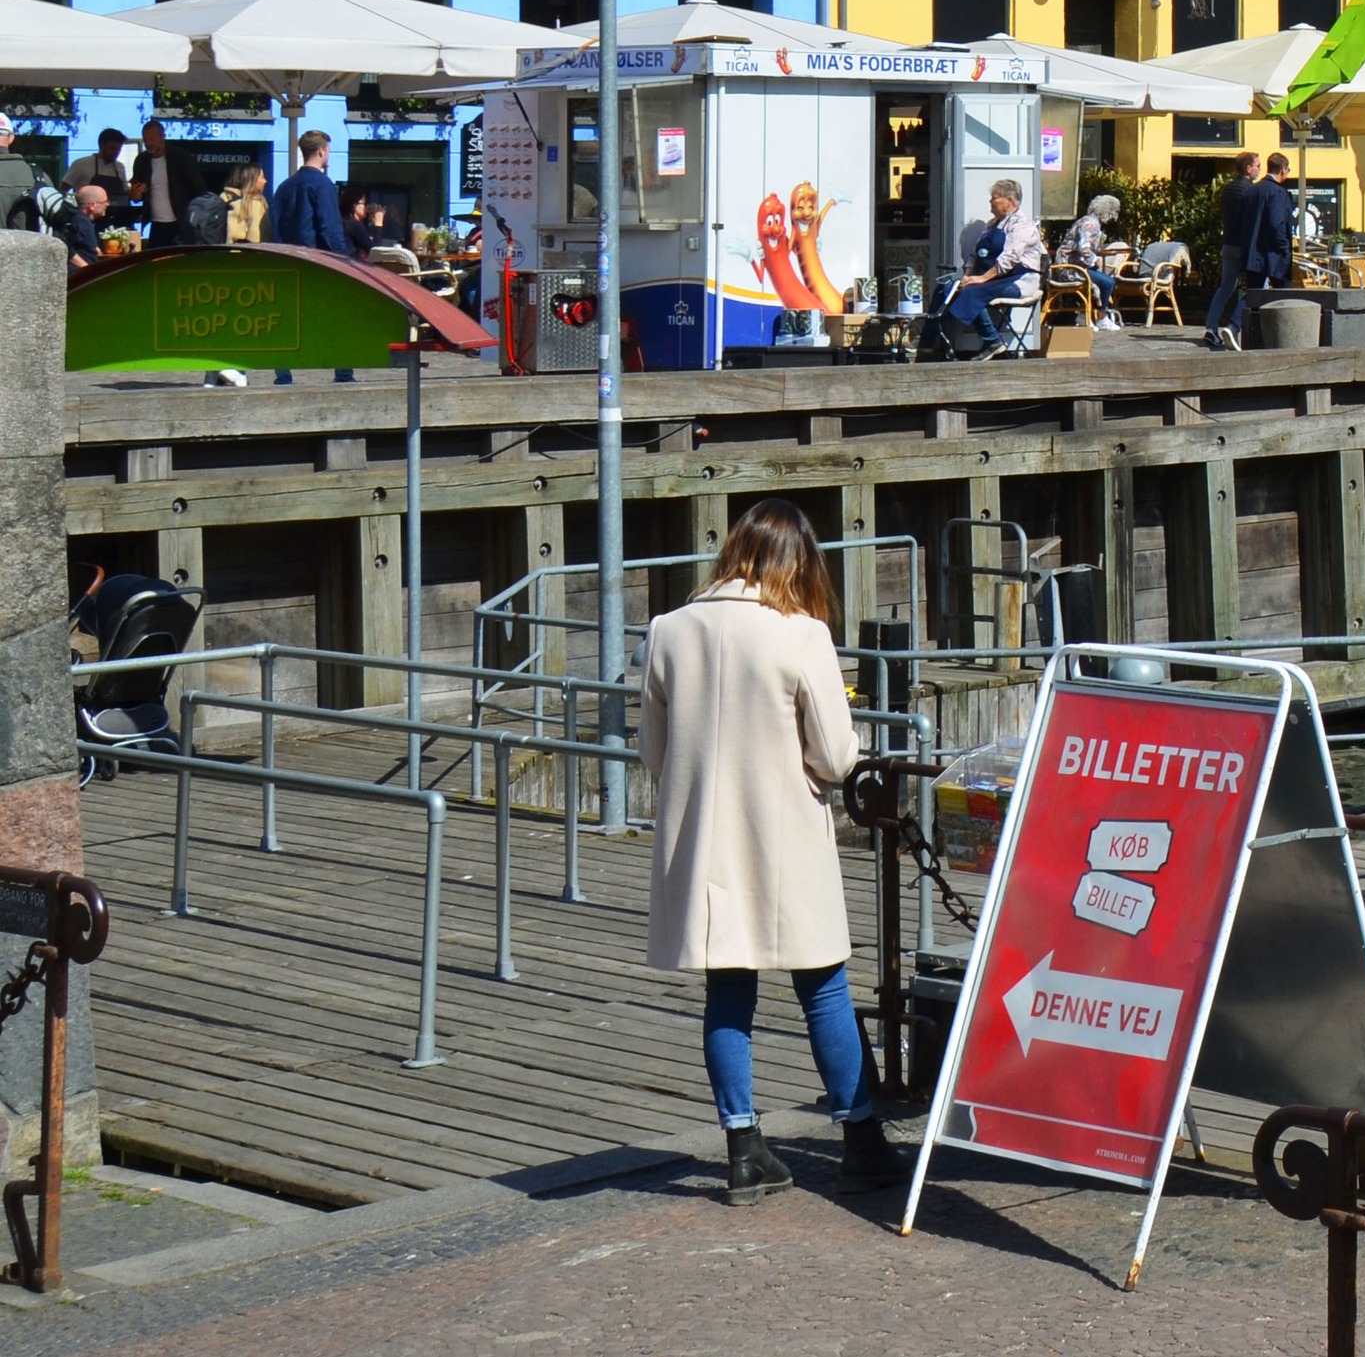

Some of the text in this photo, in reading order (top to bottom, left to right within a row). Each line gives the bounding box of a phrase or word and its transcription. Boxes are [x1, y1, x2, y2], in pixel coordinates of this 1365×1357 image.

[617, 51, 664, 68] ØLSER
[725, 61, 759, 72] TICAN
[807, 53, 958, 75] MIA'S FODERBRÆT
[1002, 70, 1031, 82] TICAN
[211, 123, 221, 136] 5
[197, 154, 250, 163] FÆRGEKRO
[176, 281, 276, 308] HOP ON
[173, 313, 282, 338] HOP OFF
[668, 315, 695, 326] TICAN
[1058, 736, 1245, 794] BILLETTER
[1109, 833, 1149, 860] KØB
[1086, 884, 1143, 920] BILLET
[1030, 990, 1162, 1037] DENNE VEJ
[1095, 1148, 1147, 1165] STROMMA.COM
